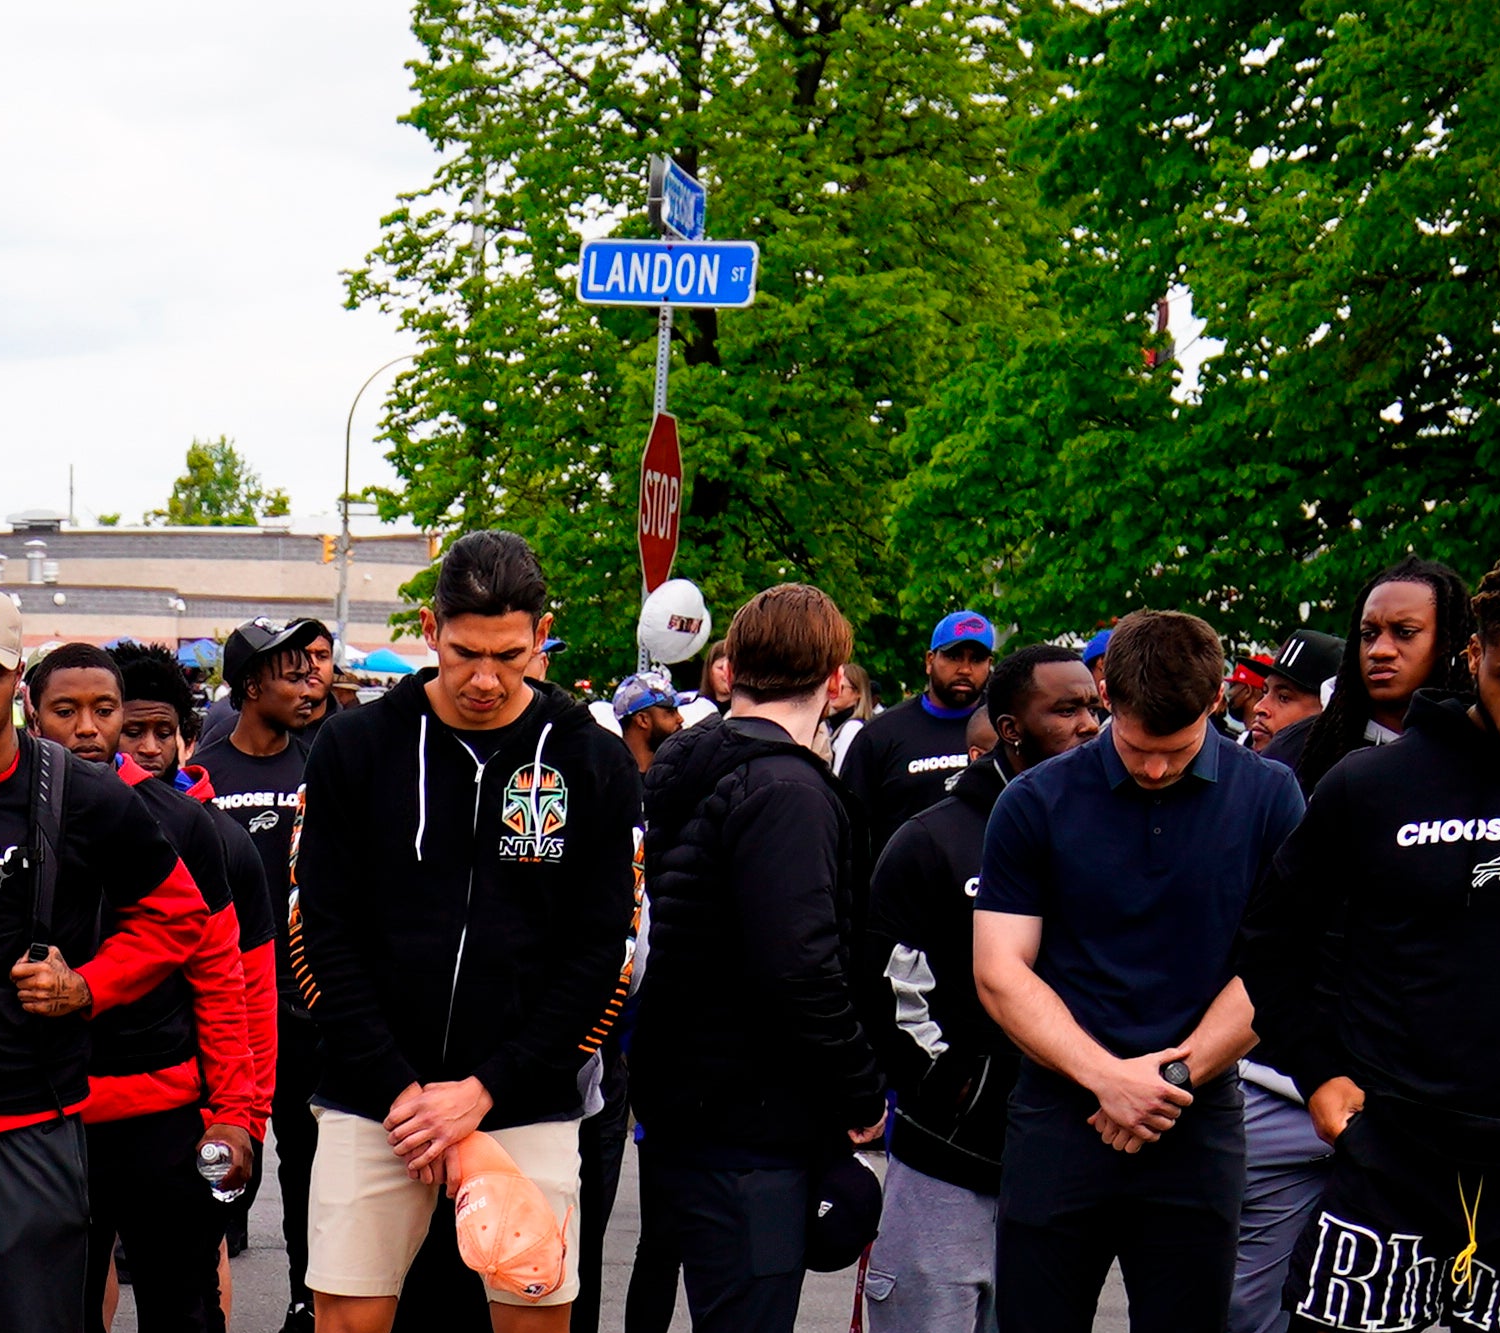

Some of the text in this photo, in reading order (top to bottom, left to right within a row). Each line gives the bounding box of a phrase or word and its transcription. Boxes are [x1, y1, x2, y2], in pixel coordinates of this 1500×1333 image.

[587, 250, 746, 295] LANDON ST
[642, 468, 679, 540] STOP
[908, 753, 968, 774] CHOOSE
[277, 792, 300, 807] LO
